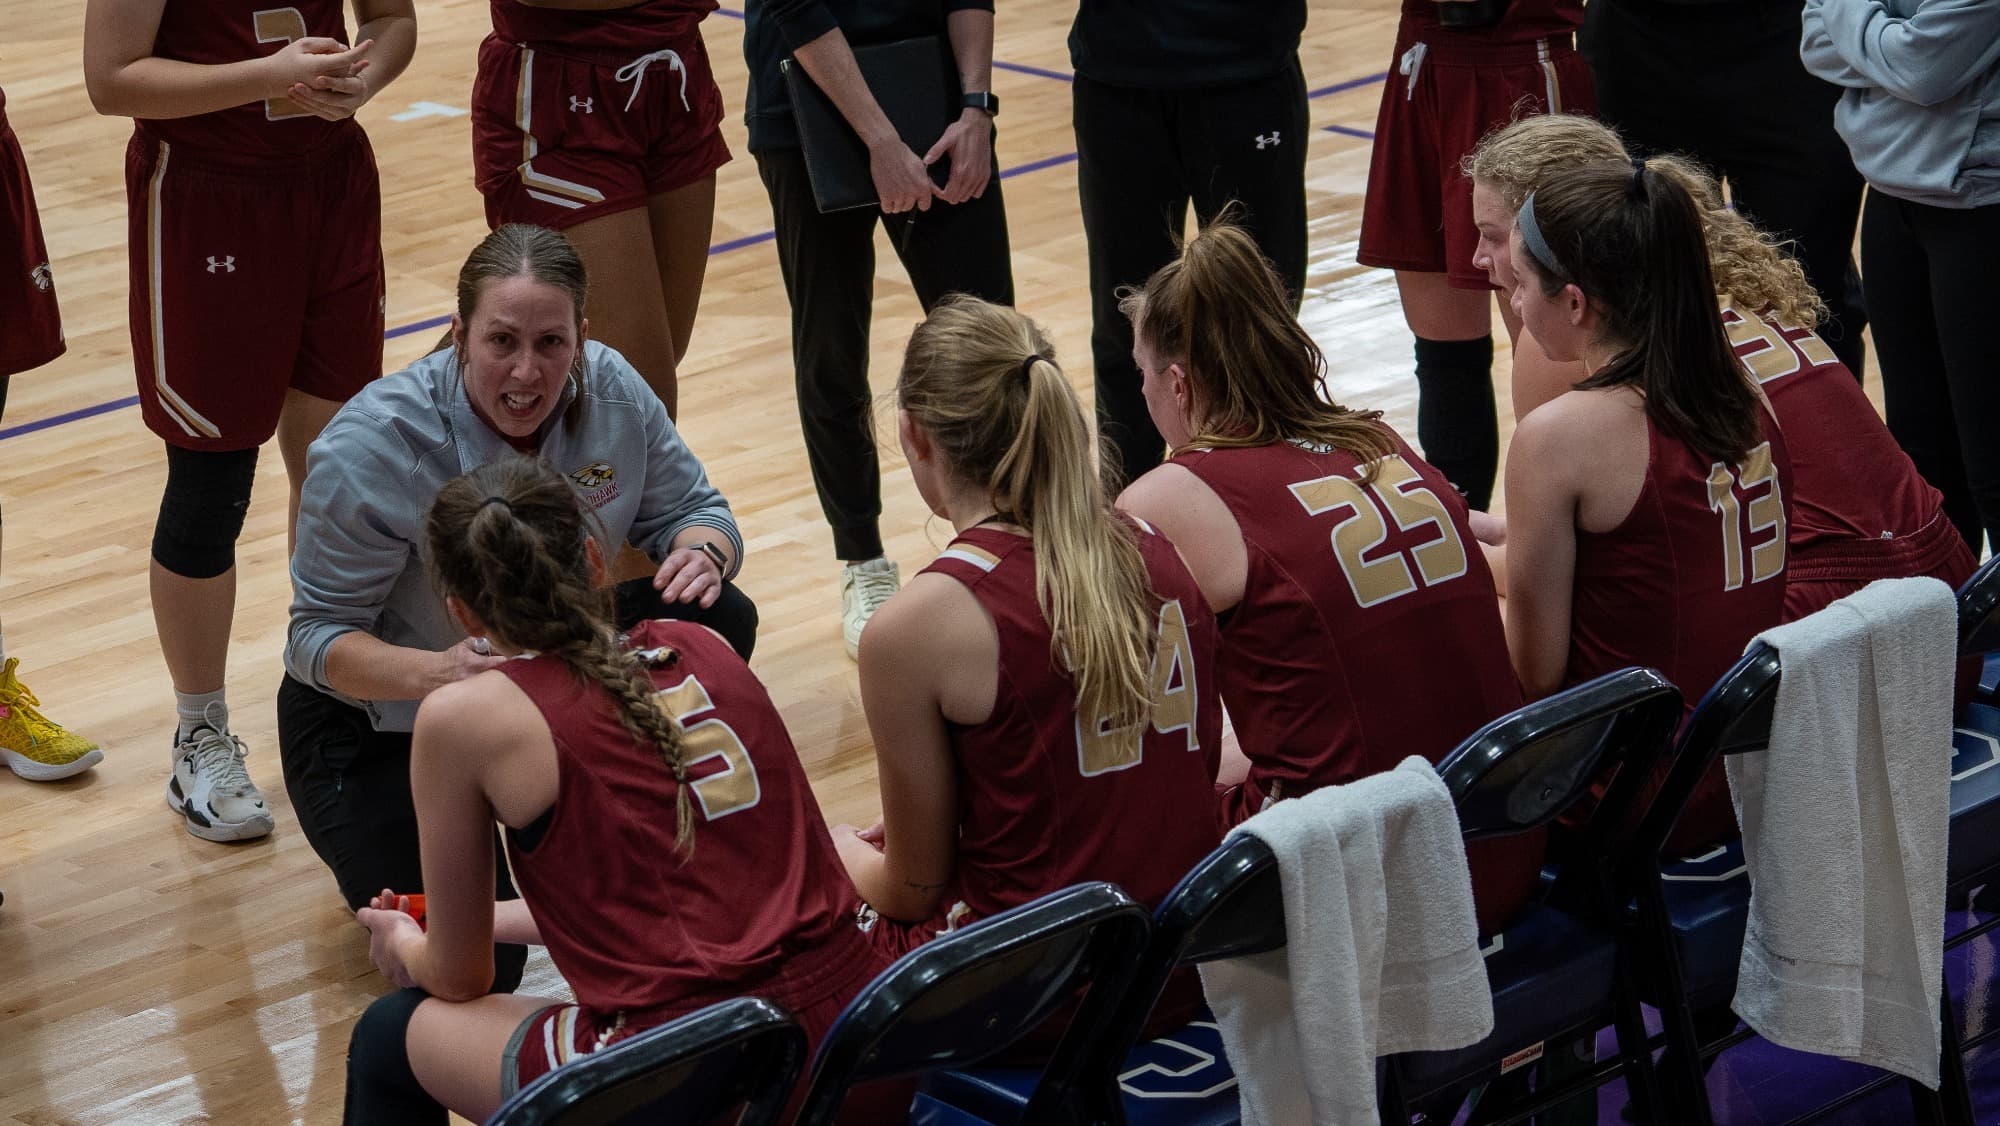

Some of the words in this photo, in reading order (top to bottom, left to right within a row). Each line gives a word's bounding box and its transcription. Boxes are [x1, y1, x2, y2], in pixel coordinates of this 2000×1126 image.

[1287, 453, 1467, 608] 25
[1706, 440, 1786, 592] 13
[650, 673, 761, 822] 5
